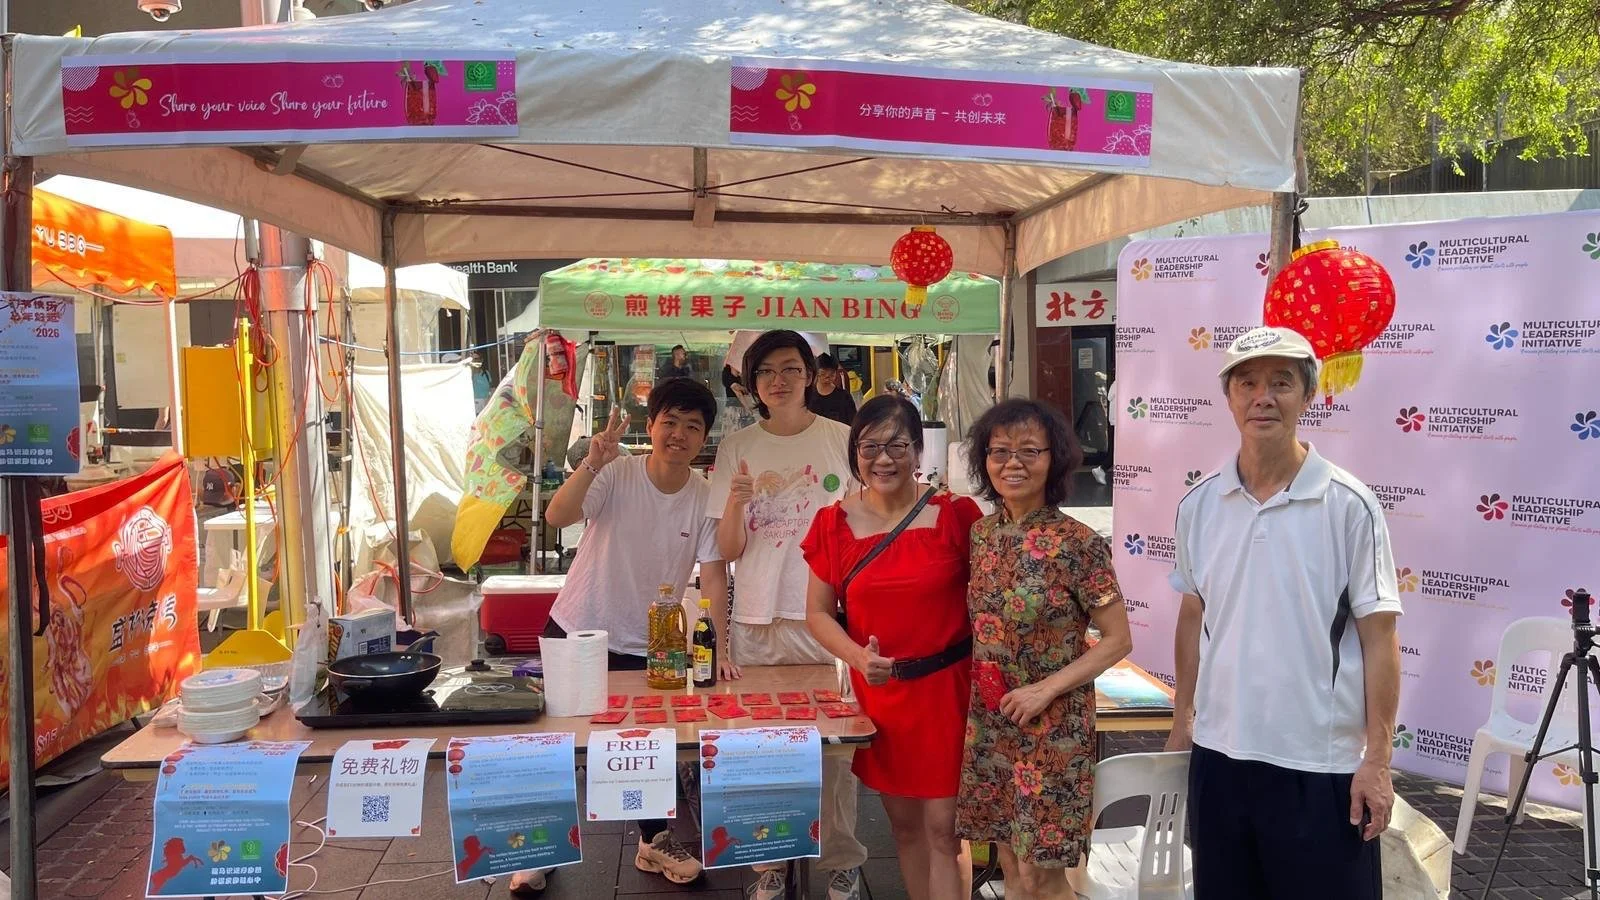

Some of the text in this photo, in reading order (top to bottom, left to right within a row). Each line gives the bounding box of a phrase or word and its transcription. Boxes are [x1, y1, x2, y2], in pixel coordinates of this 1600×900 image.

[159, 90, 388, 120] Share your voice Share your future
[859, 103, 937, 122] 分享你的声音
[954, 109, 1006, 125] 共创未来
[1439, 234, 1530, 248] MULTICULTURAL
[1438, 246, 1507, 256] LEADERSHIP
[1156, 254, 1220, 264] MULTICULTURAL
[1438, 255, 1494, 266] INITIATIVE
[448, 262, 518, 274] ealth Bank
[1155, 263, 1203, 271] LEADERSHIP
[624, 294, 923, 320] 煎饼果子 JIAN BING
[1046, 290, 1108, 321] 北方
[36, 328, 60, 338] 2026
[1522, 330, 1595, 338] LEADERSHIP
[1522, 339, 1582, 348] INITIATIVE
[1150, 397, 1212, 406] MULTICULTURAL
[1429, 407, 1518, 417] MULTICULTURAL
[1429, 416, 1496, 425] LEADERSHIP
[1428, 424, 1483, 433] INITIATIVE
[1512, 495, 1600, 509] MULTICULTURA
[1512, 504, 1584, 516] LEADERSHIP
[1512, 513, 1570, 525] INITIATIVE
[1422, 570, 1510, 587] MULTICULTURAL
[1422, 579, 1488, 593] LEADERSHIP
[1422, 587, 1476, 600] INITIATIVE
[1508, 673, 1546, 686] EADE
[788, 735, 808, 743] 2026
[605, 740, 660, 752] FREE
[1416, 744, 1469, 762] INITIATIVE
[340, 757, 419, 775] 免费礼物
[607, 756, 658, 771] GIFT
